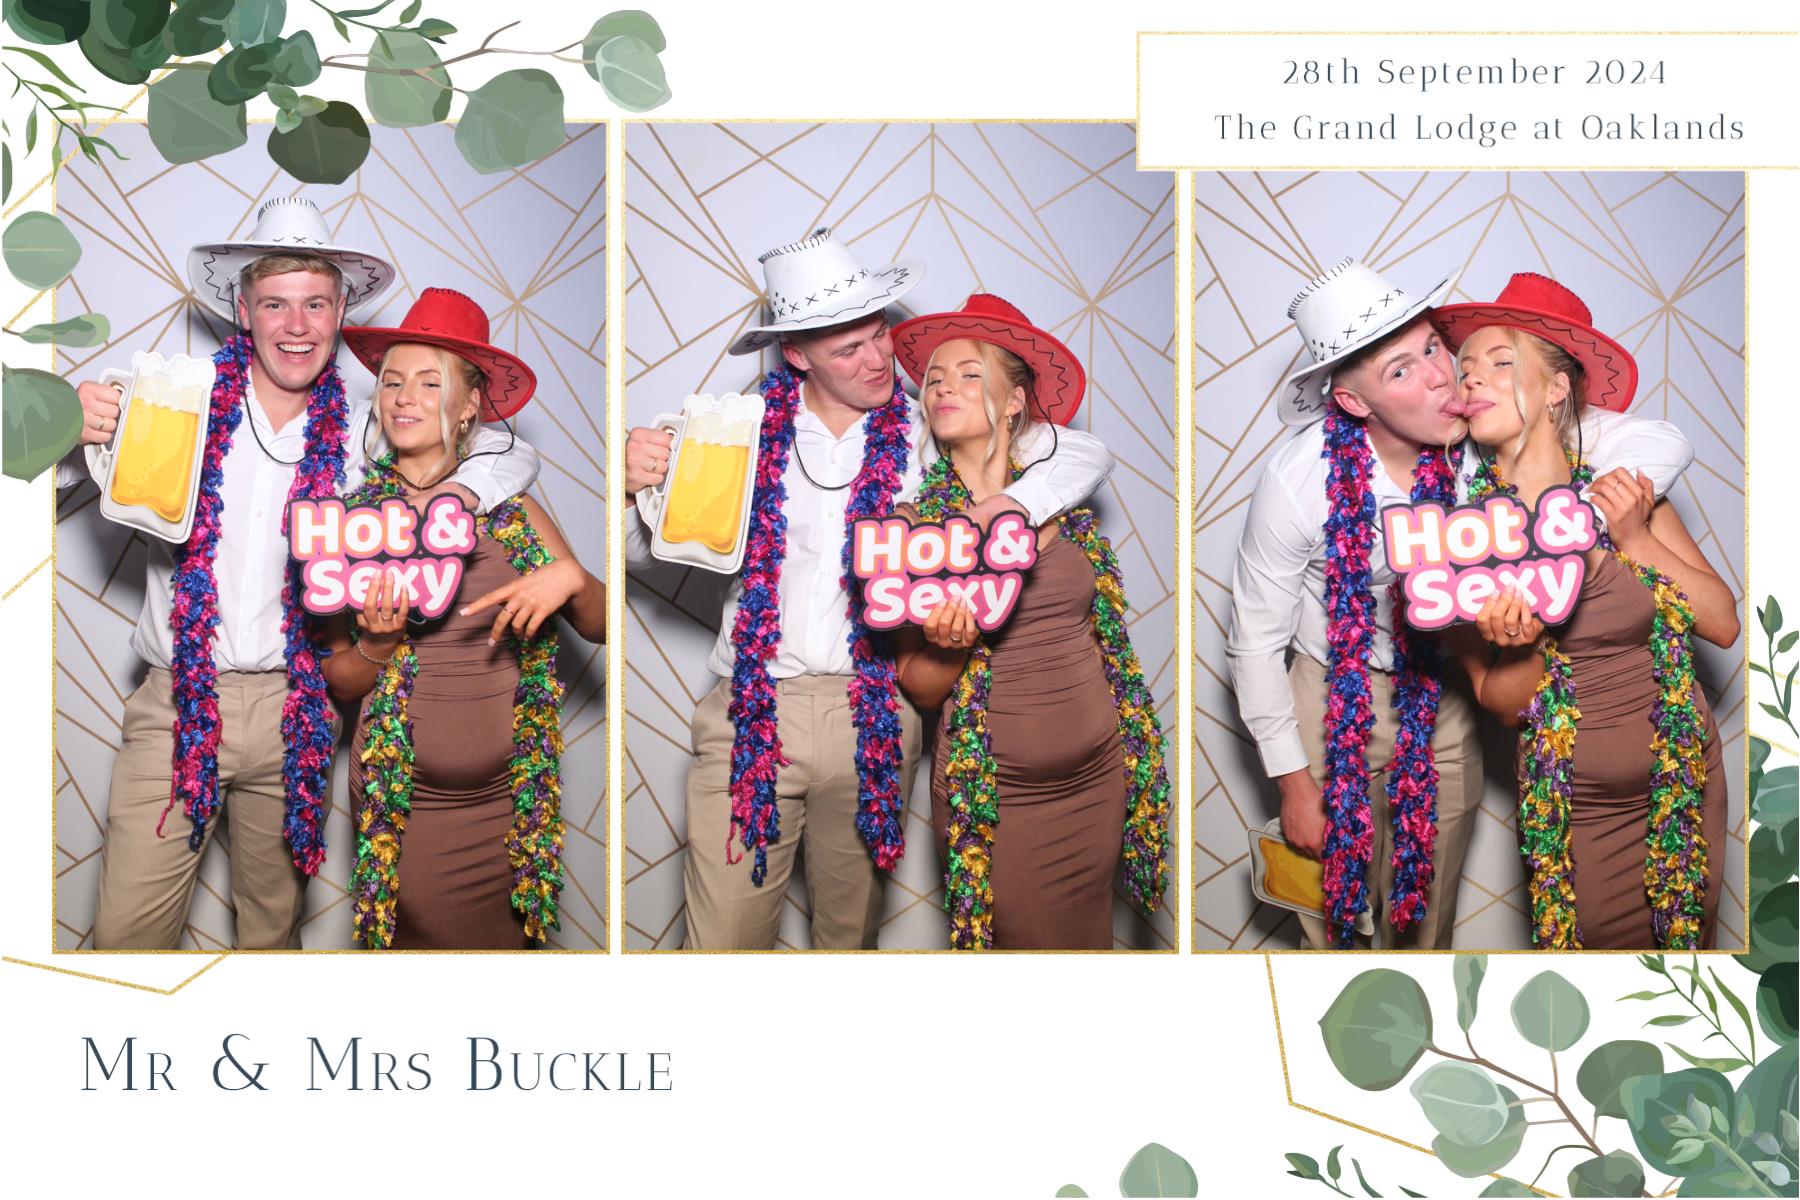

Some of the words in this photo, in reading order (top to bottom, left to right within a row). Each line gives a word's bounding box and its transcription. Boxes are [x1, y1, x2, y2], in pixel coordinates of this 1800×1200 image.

[297, 505, 412, 555] Hot
[426, 501, 471, 550] &
[859, 523, 975, 573] Hot
[987, 519, 1032, 566] &
[1390, 503, 1523, 567] Hot
[1539, 494, 1591, 548] &
